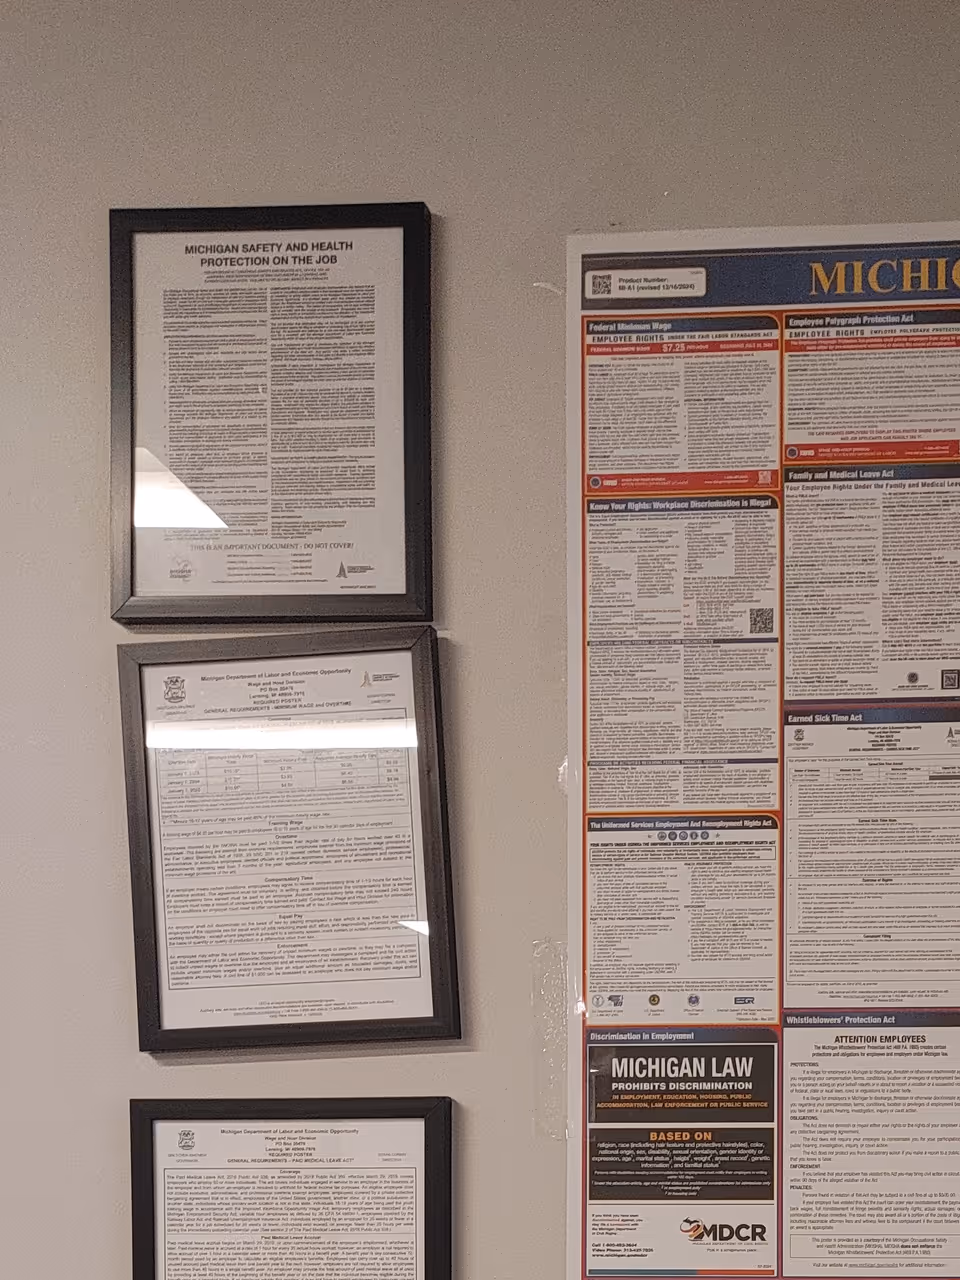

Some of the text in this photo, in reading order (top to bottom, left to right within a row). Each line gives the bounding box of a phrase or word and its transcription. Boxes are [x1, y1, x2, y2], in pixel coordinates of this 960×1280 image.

[184, 241, 353, 254] MICHIGAN SAFETY AND HEALTH
[200, 255, 338, 267] PROTECTION ON THE JOB
[789, 314, 914, 327] Employee Polygraph Protection Act
[662, 343, 686, 352] $7.25
[788, 472, 813, 481] Family
[829, 471, 858, 479] Medical
[881, 470, 894, 478] Act
[627, 502, 652, 511] Rights:
[652, 501, 689, 510] Workplace
[690, 500, 740, 508] Discrimination
[749, 499, 772, 508] Illegal
[651, 1033, 694, 1041] Employment
[611, 1057, 753, 1078] MICHIGAN LAW
[650, 1132, 712, 1141] BASED ON
[700, 1224, 766, 1241] MDCR
